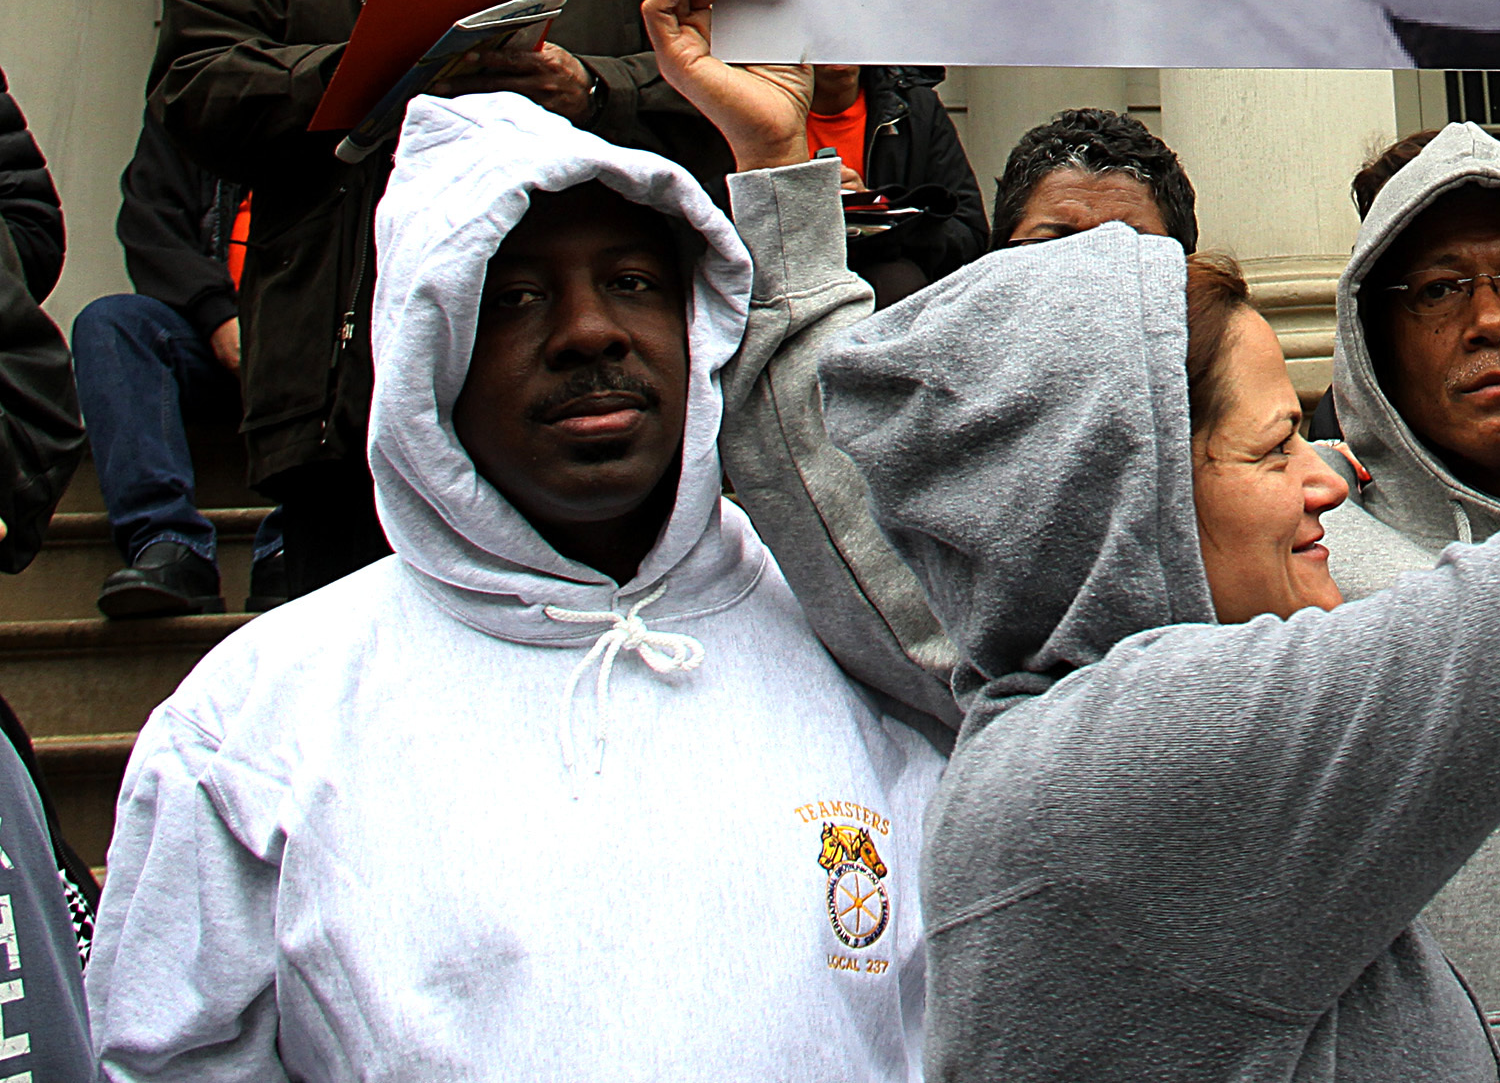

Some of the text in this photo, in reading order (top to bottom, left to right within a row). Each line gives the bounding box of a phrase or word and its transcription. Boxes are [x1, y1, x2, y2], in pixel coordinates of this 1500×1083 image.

[794, 800, 890, 836] TEAMSTERS
[827, 954, 889, 975] LOCAL 237
